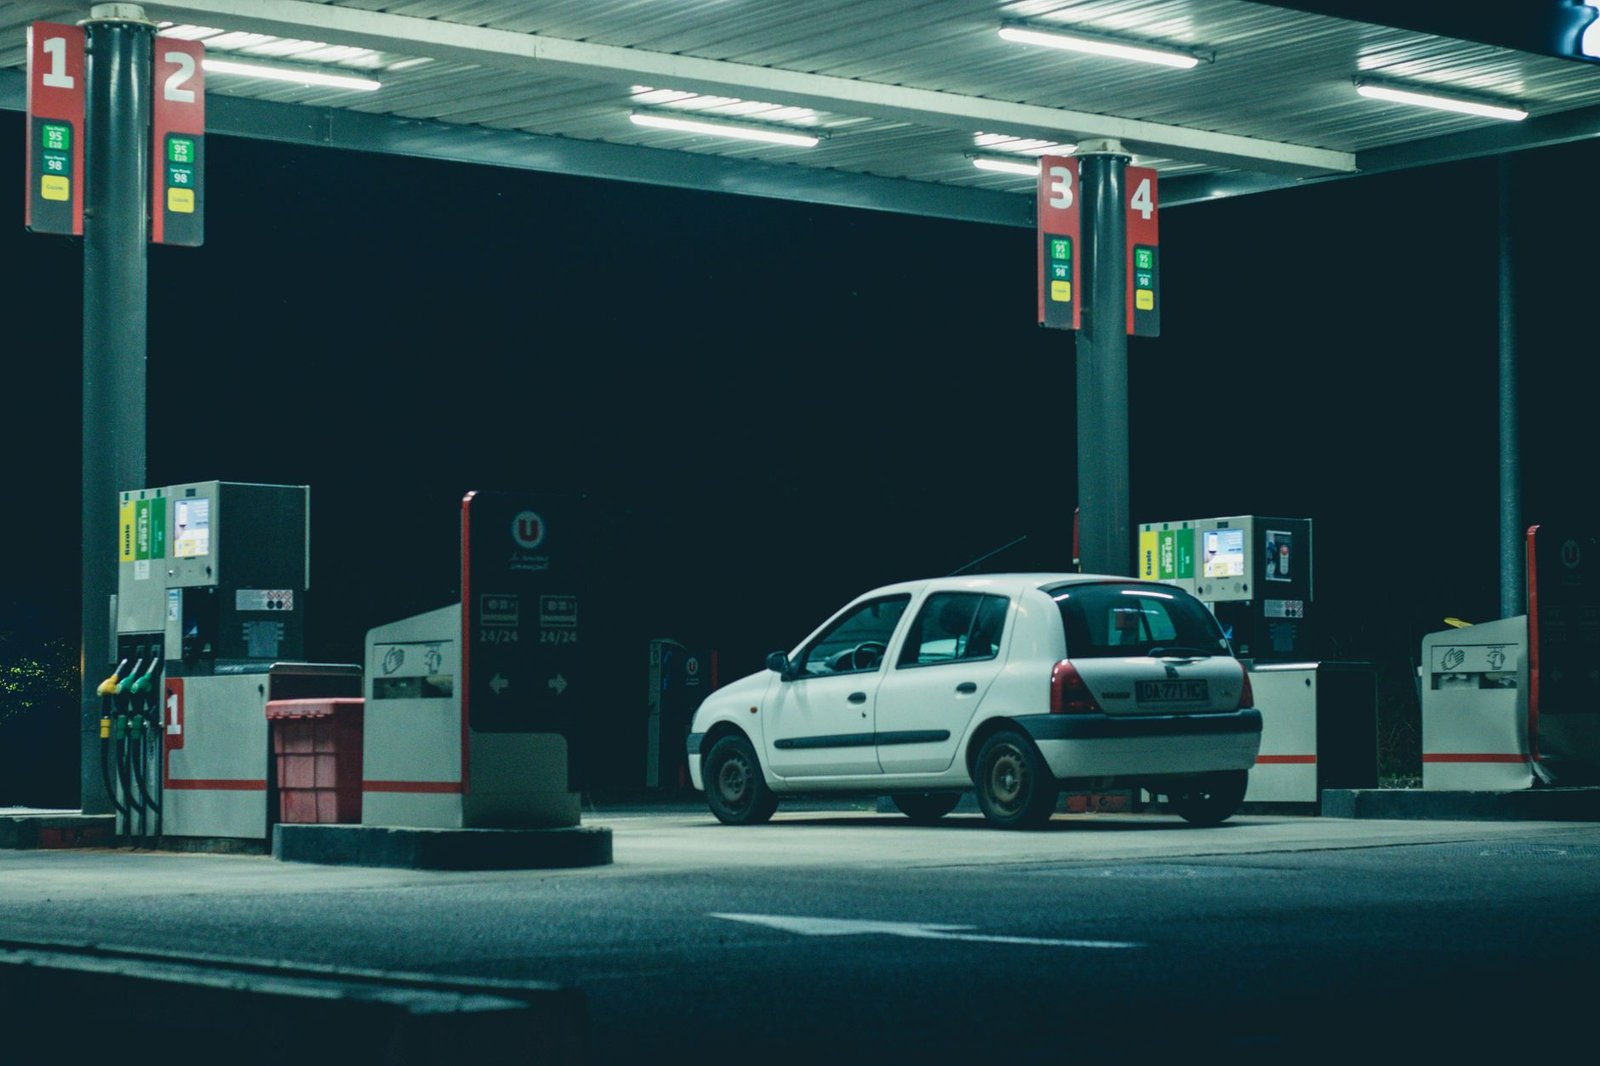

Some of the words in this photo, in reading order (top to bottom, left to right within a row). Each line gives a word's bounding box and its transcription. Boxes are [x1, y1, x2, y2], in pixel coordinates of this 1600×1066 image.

[43, 37, 74, 89] 1
[164, 51, 195, 103] 2
[48, 131, 63, 141] 95
[174, 144, 188, 154] 95
[48, 160, 63, 171] 98
[173, 173, 188, 184] 98
[1049, 167, 1073, 209] 3
[1130, 178, 1153, 220] 4
[1055, 268, 1066, 277] 98
[1139, 277, 1149, 286] 98
[517, 519, 539, 541] U
[480, 629, 518, 645] 24/24
[539, 630, 577, 646] 24/24
[166, 693, 182, 735] 1
